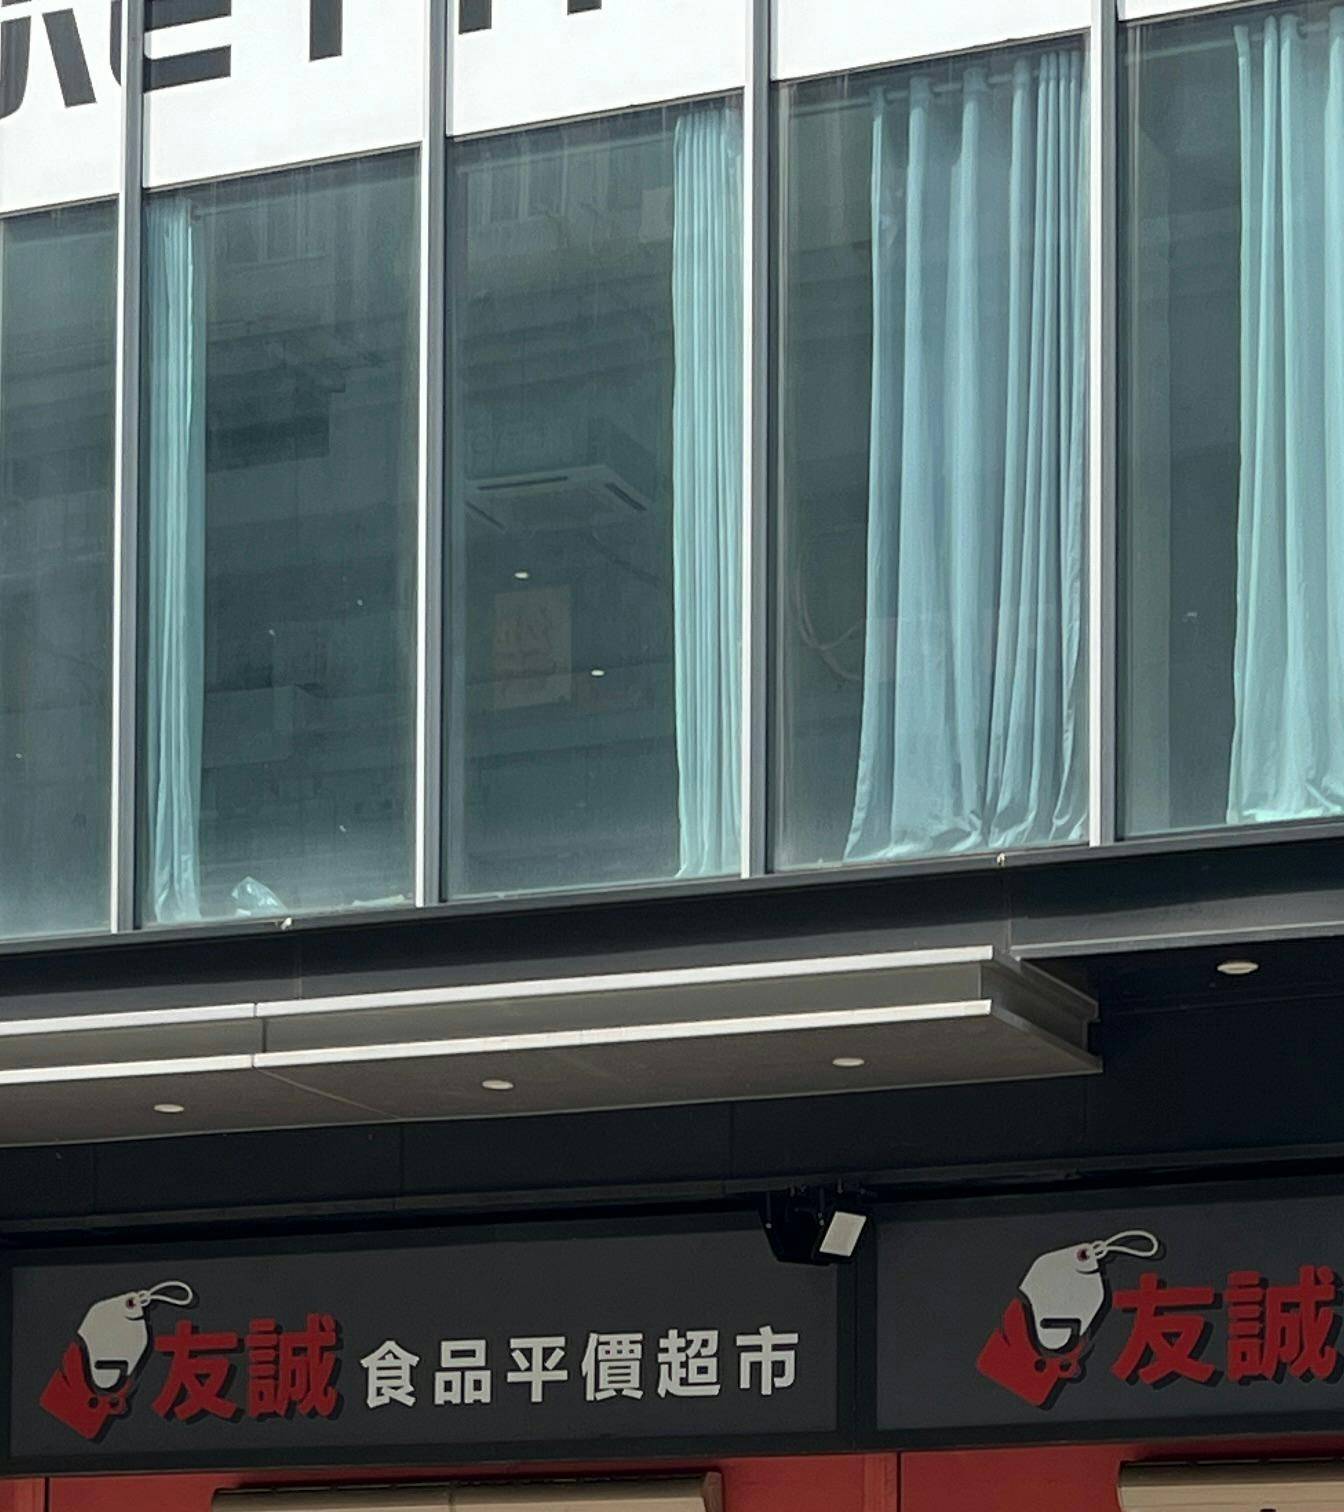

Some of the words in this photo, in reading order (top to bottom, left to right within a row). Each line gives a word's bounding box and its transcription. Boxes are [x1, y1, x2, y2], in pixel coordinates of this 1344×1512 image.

[152, 1313, 339, 1422] 友誠
[360, 1325, 802, 1409] 食品平價超市
[1112, 1264, 1343, 1387] 友誠
